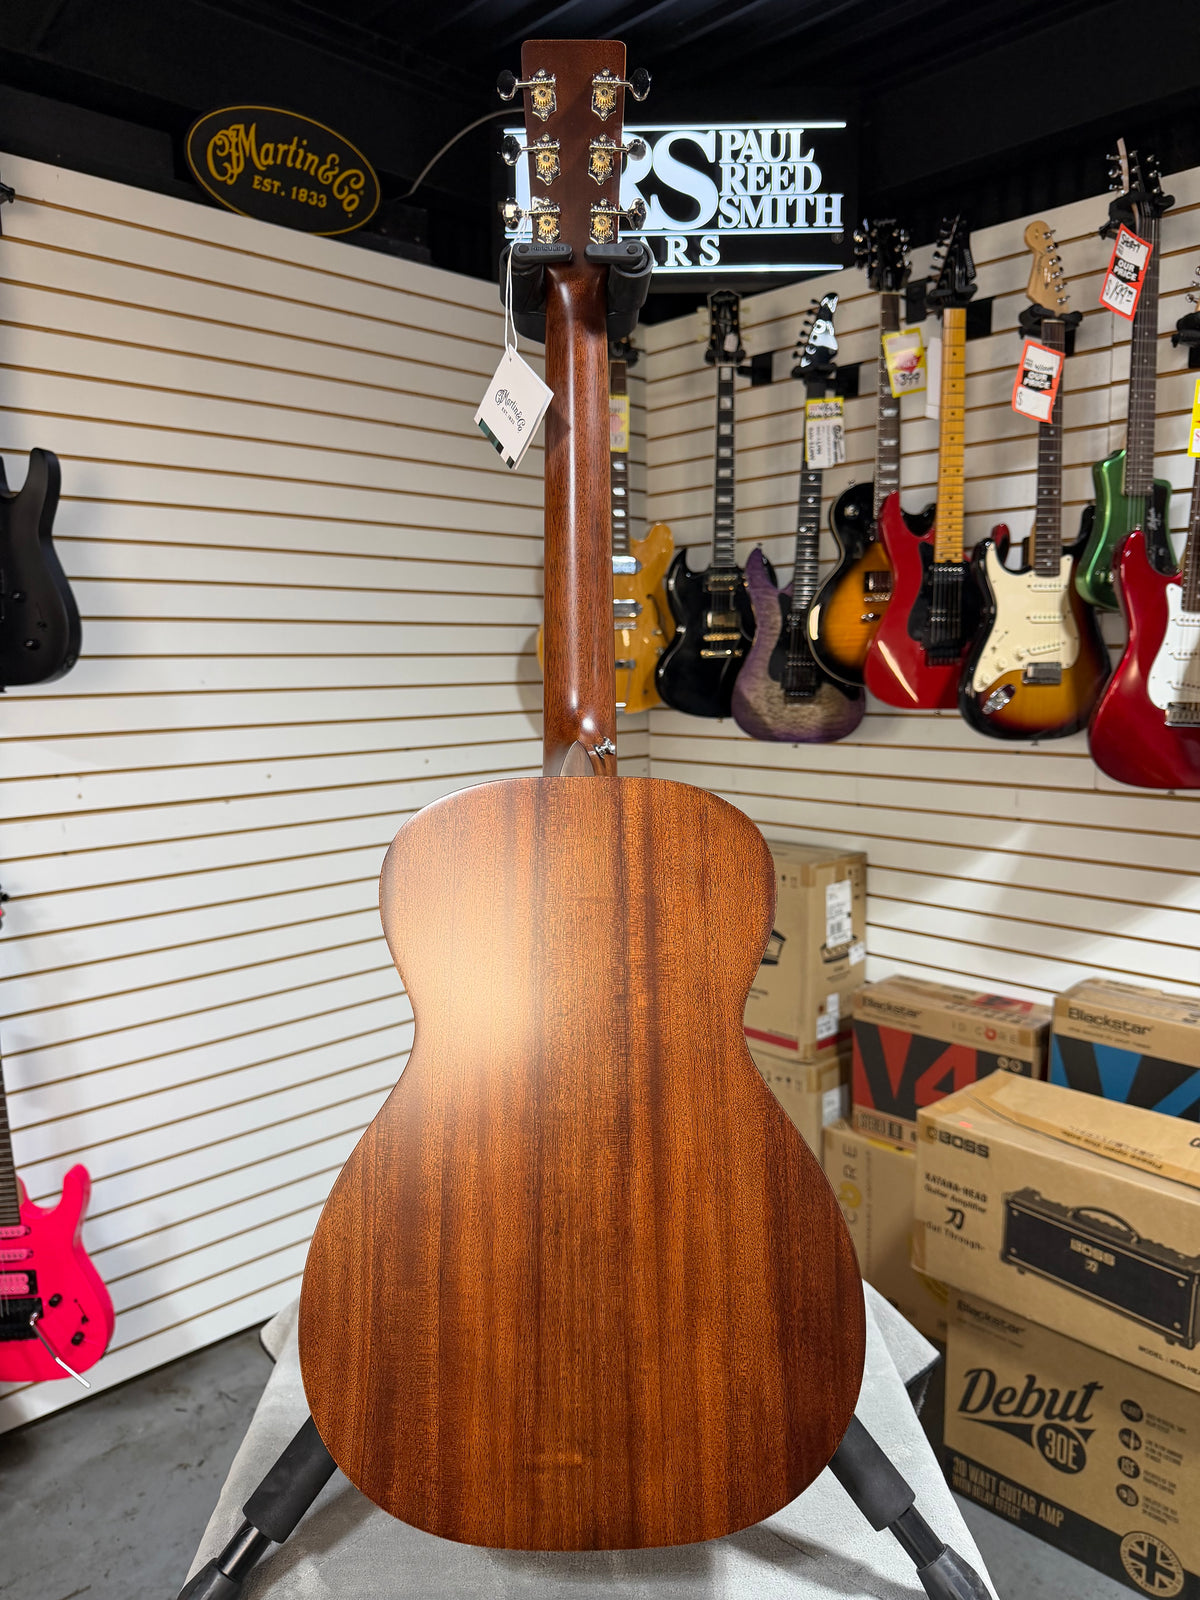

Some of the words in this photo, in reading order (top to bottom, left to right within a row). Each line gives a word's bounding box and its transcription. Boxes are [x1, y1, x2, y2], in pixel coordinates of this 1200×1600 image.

[718, 128, 815, 163] PAUL
[252, 174, 286, 197] EST.
[290, 186, 328, 208] 1833
[718, 162, 823, 196] REED
[717, 193, 845, 229] SMITH
[1113, 265, 1138, 282] PRICE
[1118, 259, 1135, 273] OUR
[1067, 1006, 1154, 1036] Blackstar
[938, 1128, 990, 1159] BOSS
[957, 1367, 1104, 1423] Debut
[1044, 1428, 1080, 1471] 30E
[952, 1456, 968, 1479] 30
[968, 1463, 998, 1494] WATT
[998, 1480, 1038, 1516] GUITAR
[1038, 1501, 1065, 1528] AMP
